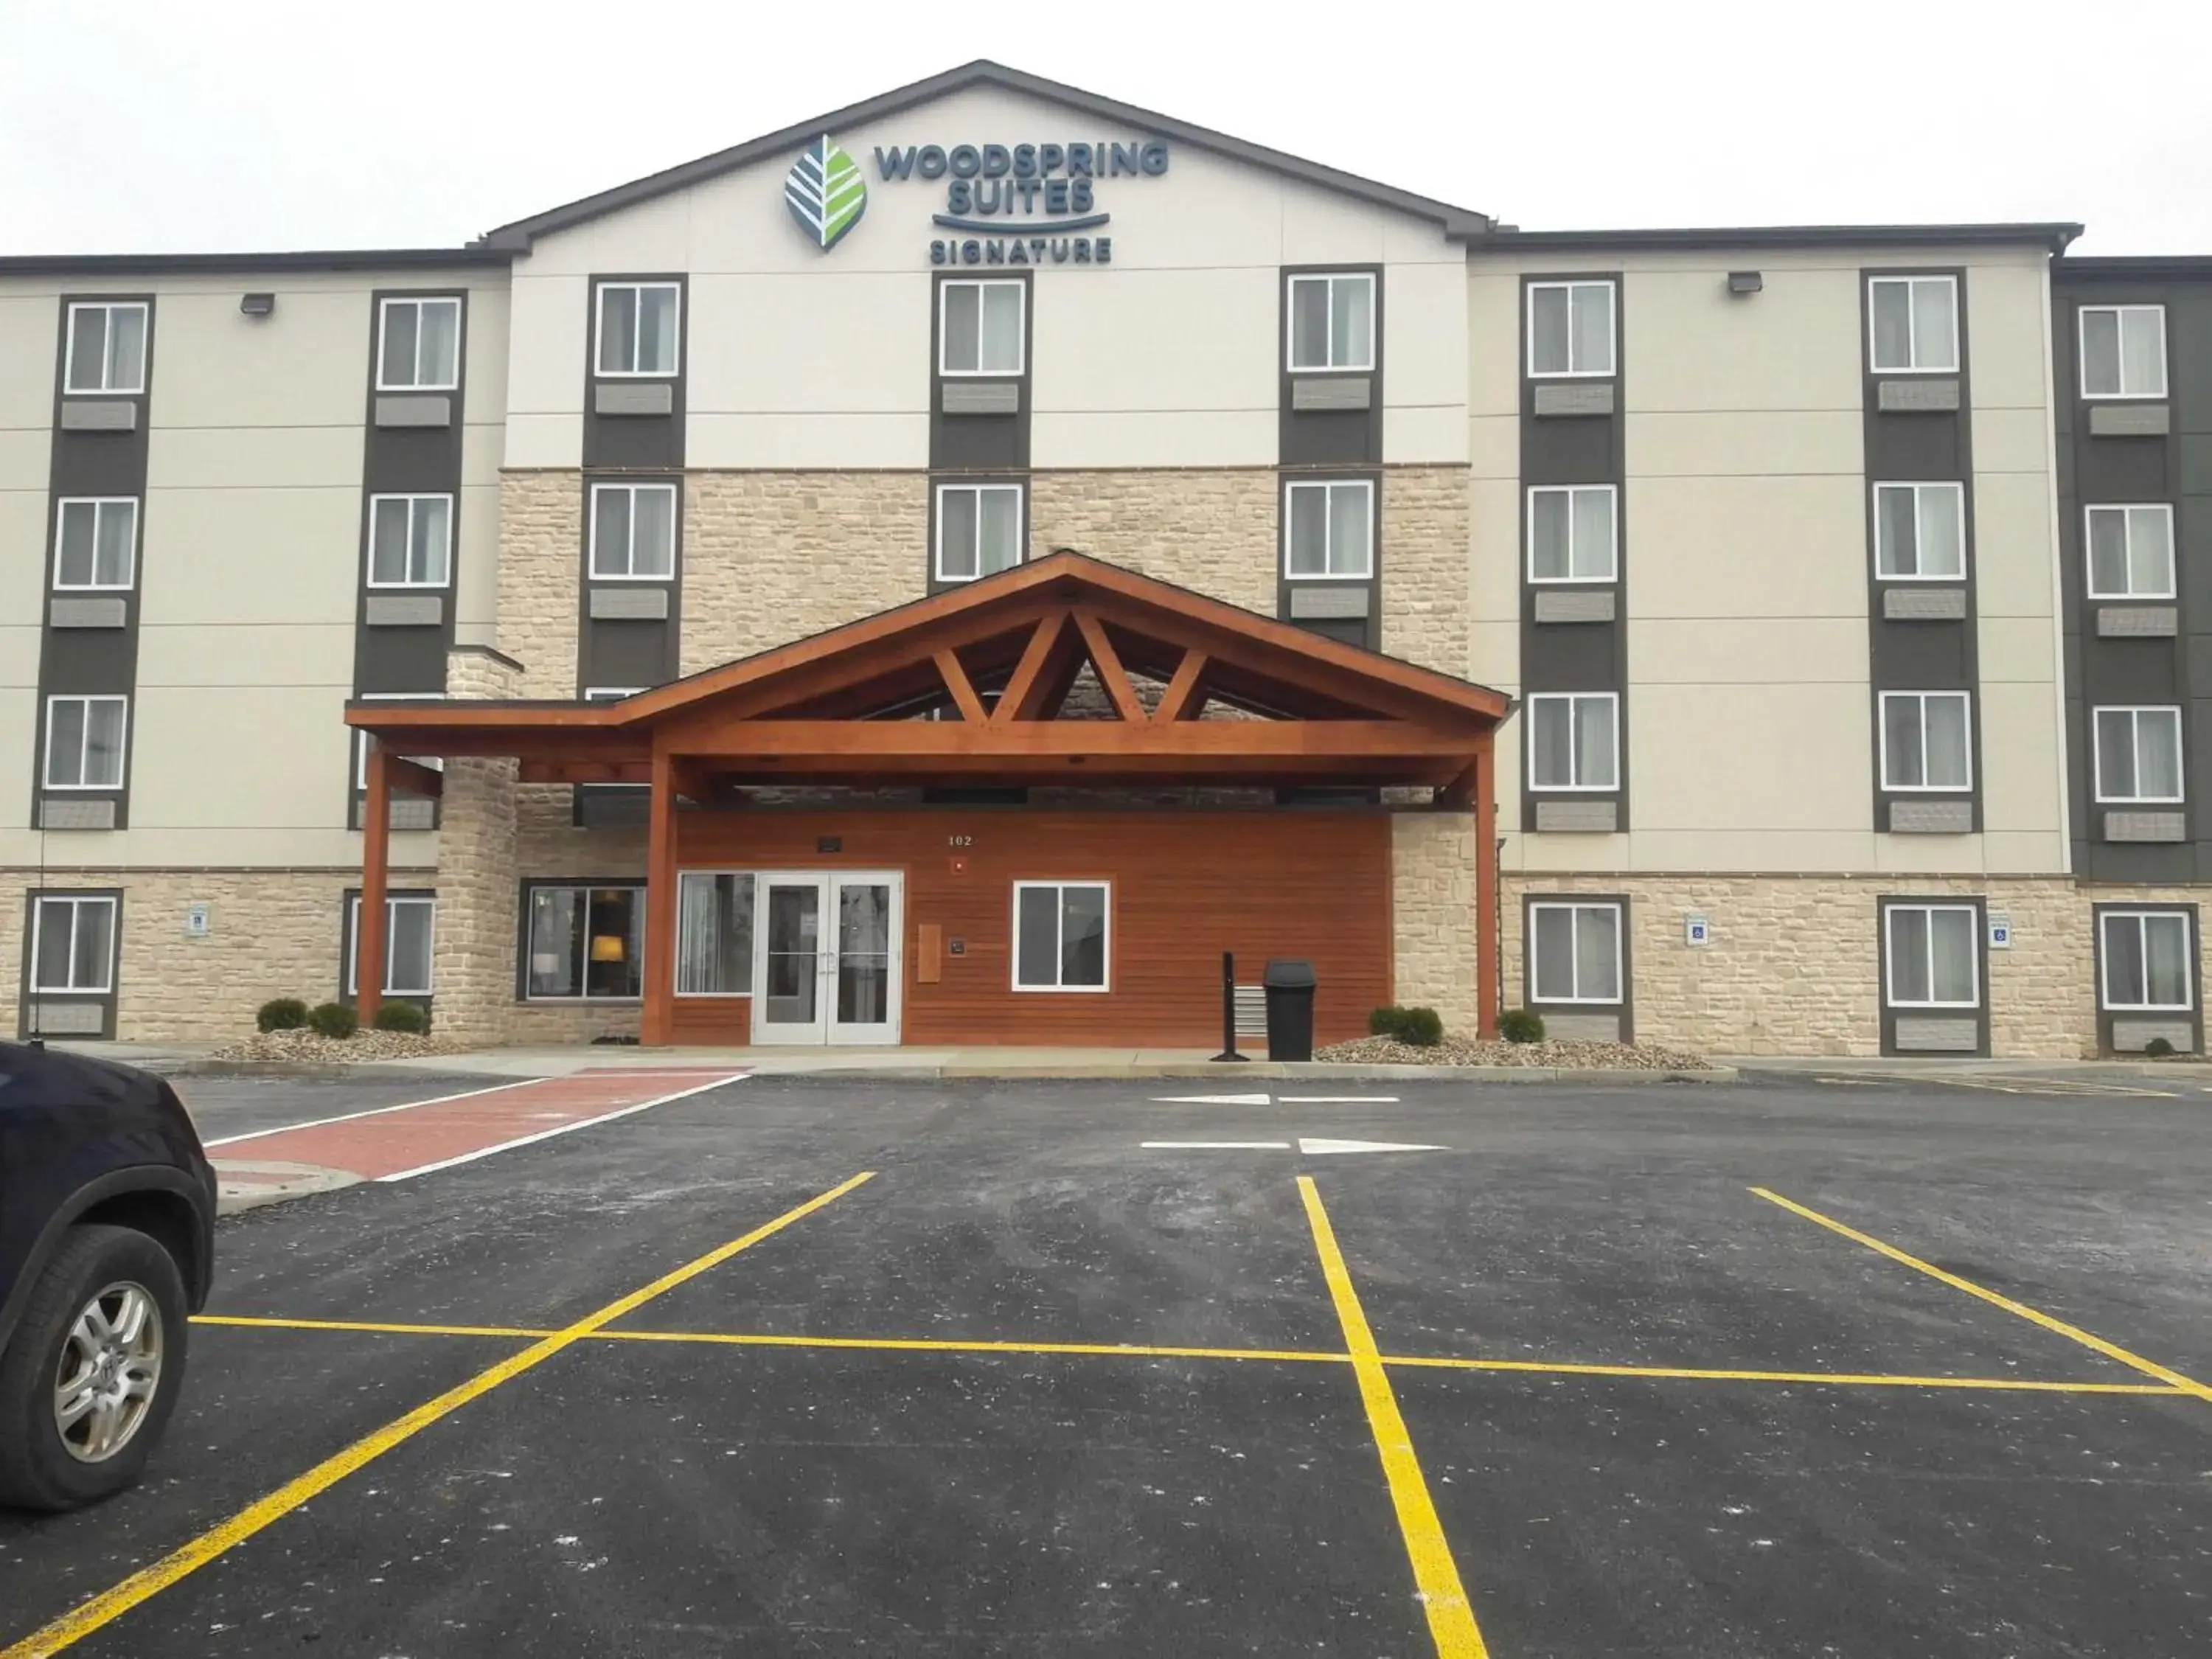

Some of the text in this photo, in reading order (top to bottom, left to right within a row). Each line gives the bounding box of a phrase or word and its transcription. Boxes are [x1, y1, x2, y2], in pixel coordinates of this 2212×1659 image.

[874, 141, 1169, 181] WOODSPRING
[947, 178, 1093, 215] SUITES
[930, 238, 1111, 264] SIGNATURE
[949, 835, 973, 846] 102
